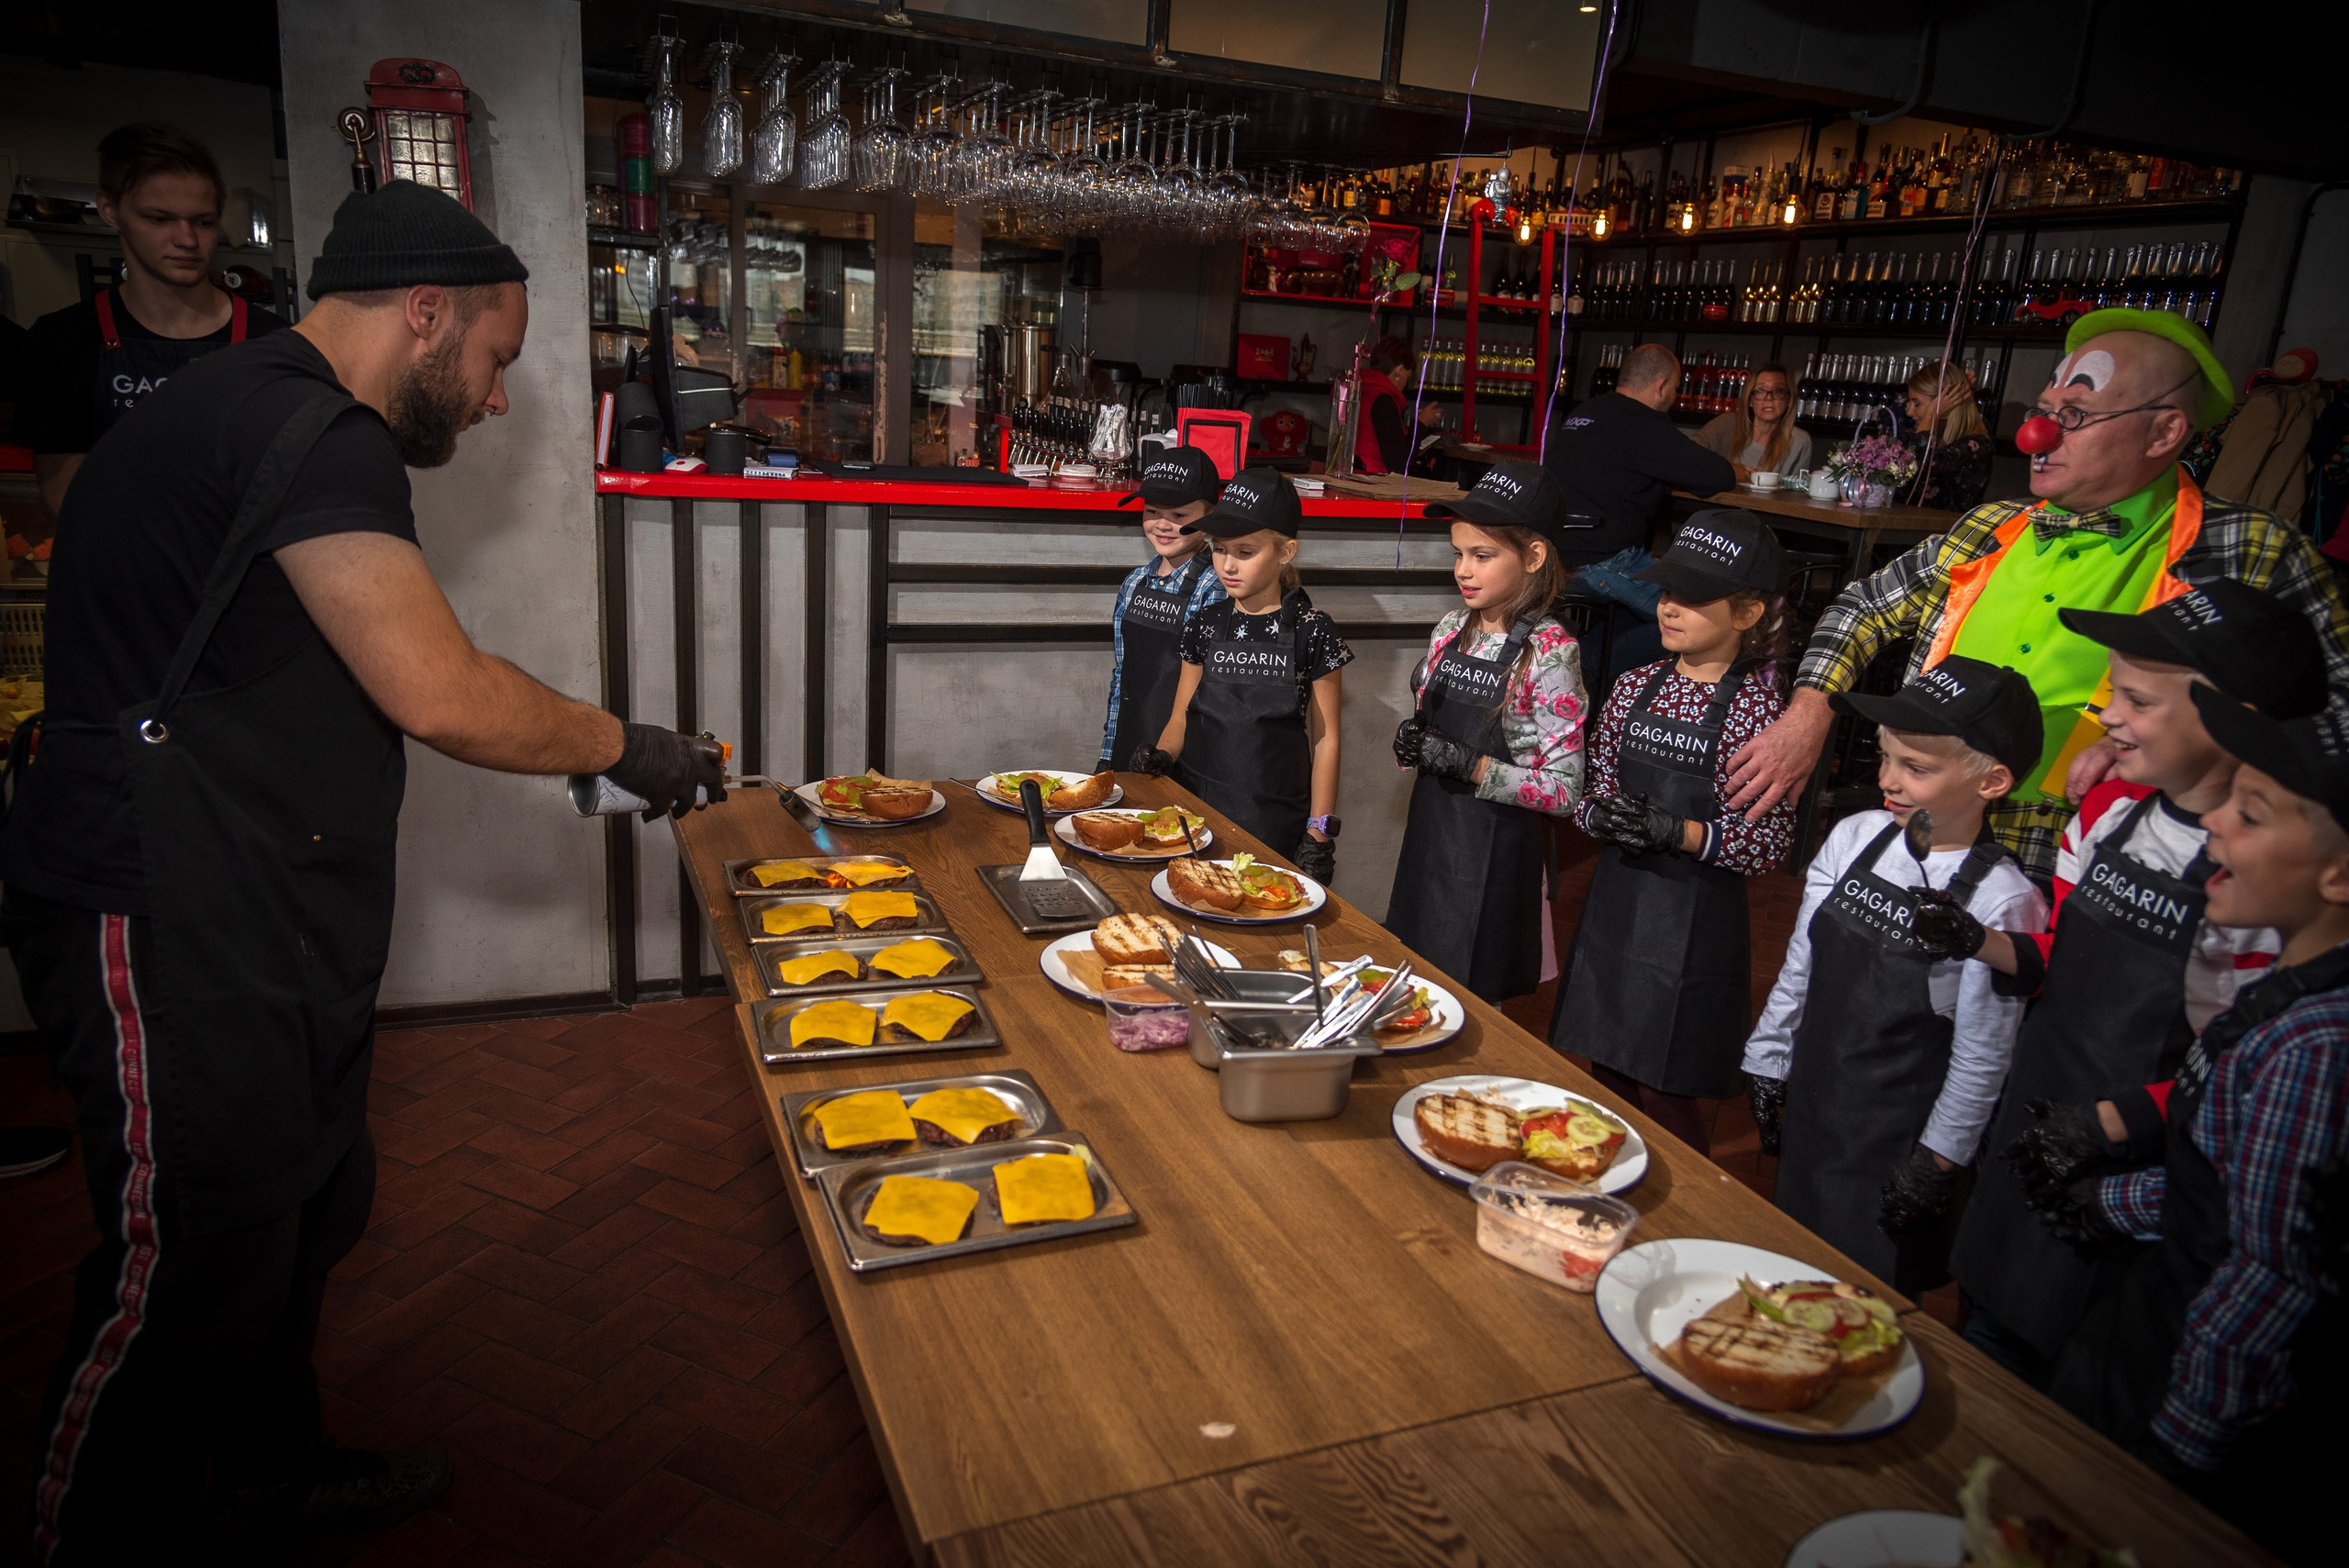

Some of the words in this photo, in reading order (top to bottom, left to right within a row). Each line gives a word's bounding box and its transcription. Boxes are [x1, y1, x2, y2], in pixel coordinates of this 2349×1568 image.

[1144, 462, 1189, 477] GAGARIN
[1226, 483, 1260, 504] GARIN
[1475, 484, 1513, 501] aurant
[1480, 472, 1522, 495] GARIN
[1221, 495, 1252, 510] aurant
[1674, 540, 1733, 566] restaurant
[1680, 526, 1742, 558] GAGARIN
[1130, 608, 1176, 625] restaurant
[1133, 595, 1182, 616] GAGARIN
[2179, 589, 2223, 626] ARIN
[1211, 665, 1286, 677] restaurant
[1214, 651, 1287, 667] GAGARIN
[1434, 674, 1495, 698] restaurant
[1441, 659, 1501, 688] GAGARIN
[1923, 669, 1966, 698] ARIN
[1630, 721, 1709, 754] GAGARIN
[1626, 739, 1704, 766] restaurant
[1843, 879, 1915, 929] GAGARI
[2091, 863, 2189, 925] GAGARIN
[1833, 897, 1914, 946] restauran
[2080, 884, 2177, 940] restaurant
[130, 1163, 150, 1219] CONNECTN
[124, 1265, 144, 1318] CONNEC
